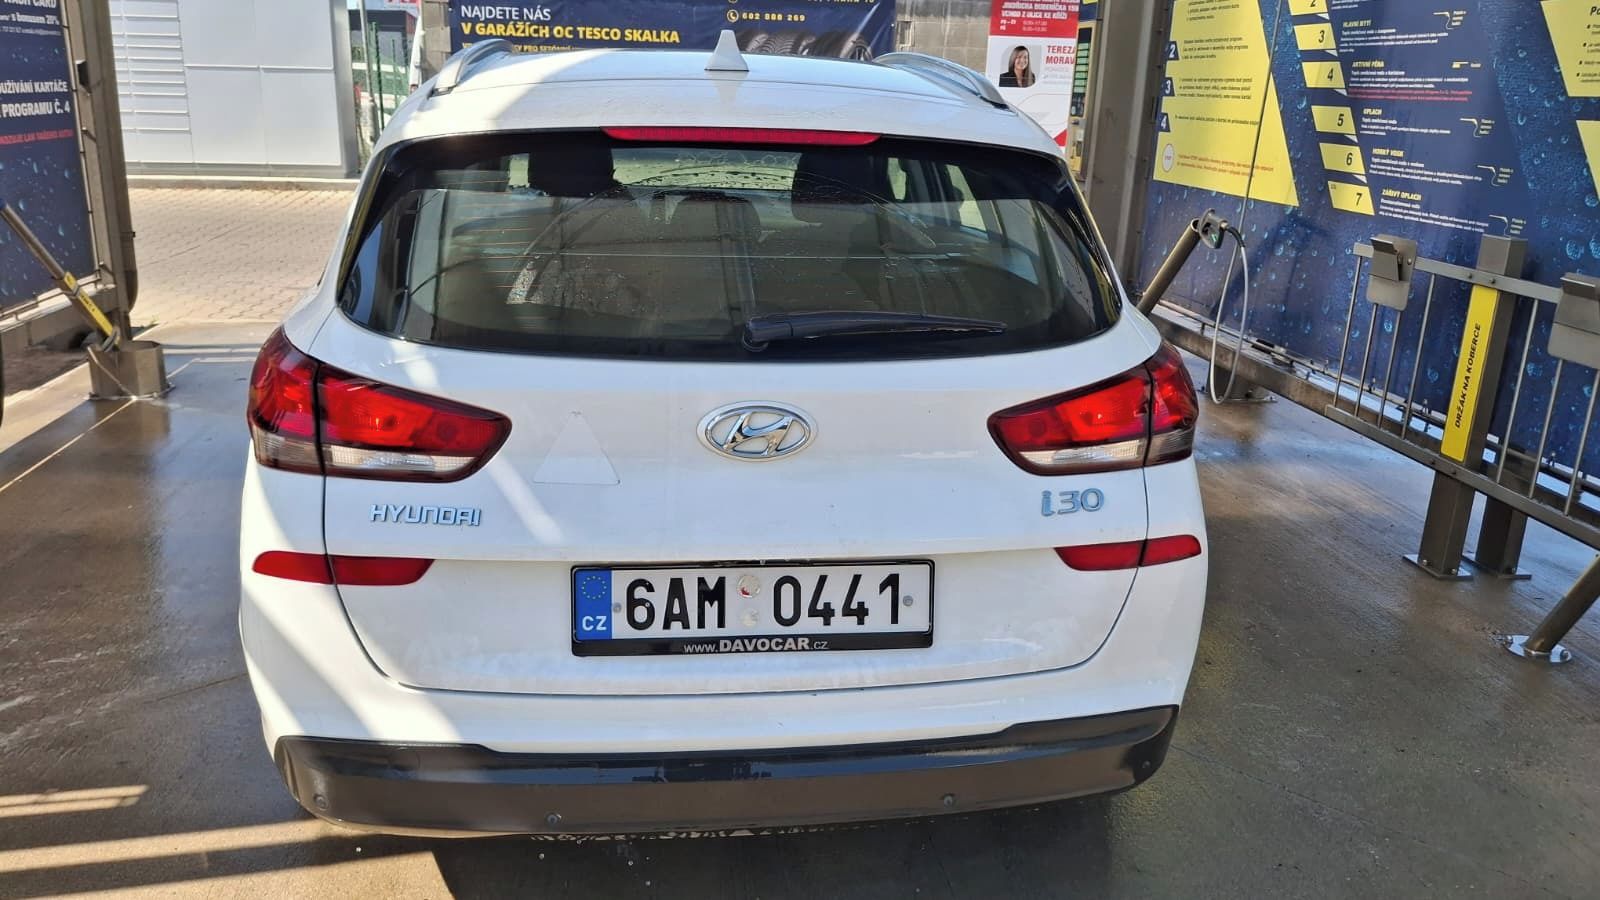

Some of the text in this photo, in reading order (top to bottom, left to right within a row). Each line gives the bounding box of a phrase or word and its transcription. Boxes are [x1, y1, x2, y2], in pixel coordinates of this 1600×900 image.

[461, 5, 551, 21] NAJDETE NÁS
[461, 21, 680, 43] V GARÁŽÍCH OC TESCO SKALKA
[1318, 30, 1325, 43] 3
[1168, 45, 1175, 57] 2
[1327, 68, 1334, 80] 4
[34, 78, 69, 93] KARTÁČE
[1165, 81, 1171, 94] 3
[2, 98, 70, 118] PROGRAMU Č. 4
[1160, 115, 1167, 129] 4
[1337, 113, 1345, 127] 5
[1346, 152, 1353, 166] 6
[1356, 193, 1363, 206] 7
[1455, 323, 1481, 428] DRŽÁK NA KOBERCE
[1041, 488, 1104, 517] i30
[370, 504, 482, 526] HYUNDAI
[626, 573, 901, 631] 6AM 0441
[582, 616, 607, 632] CZ
